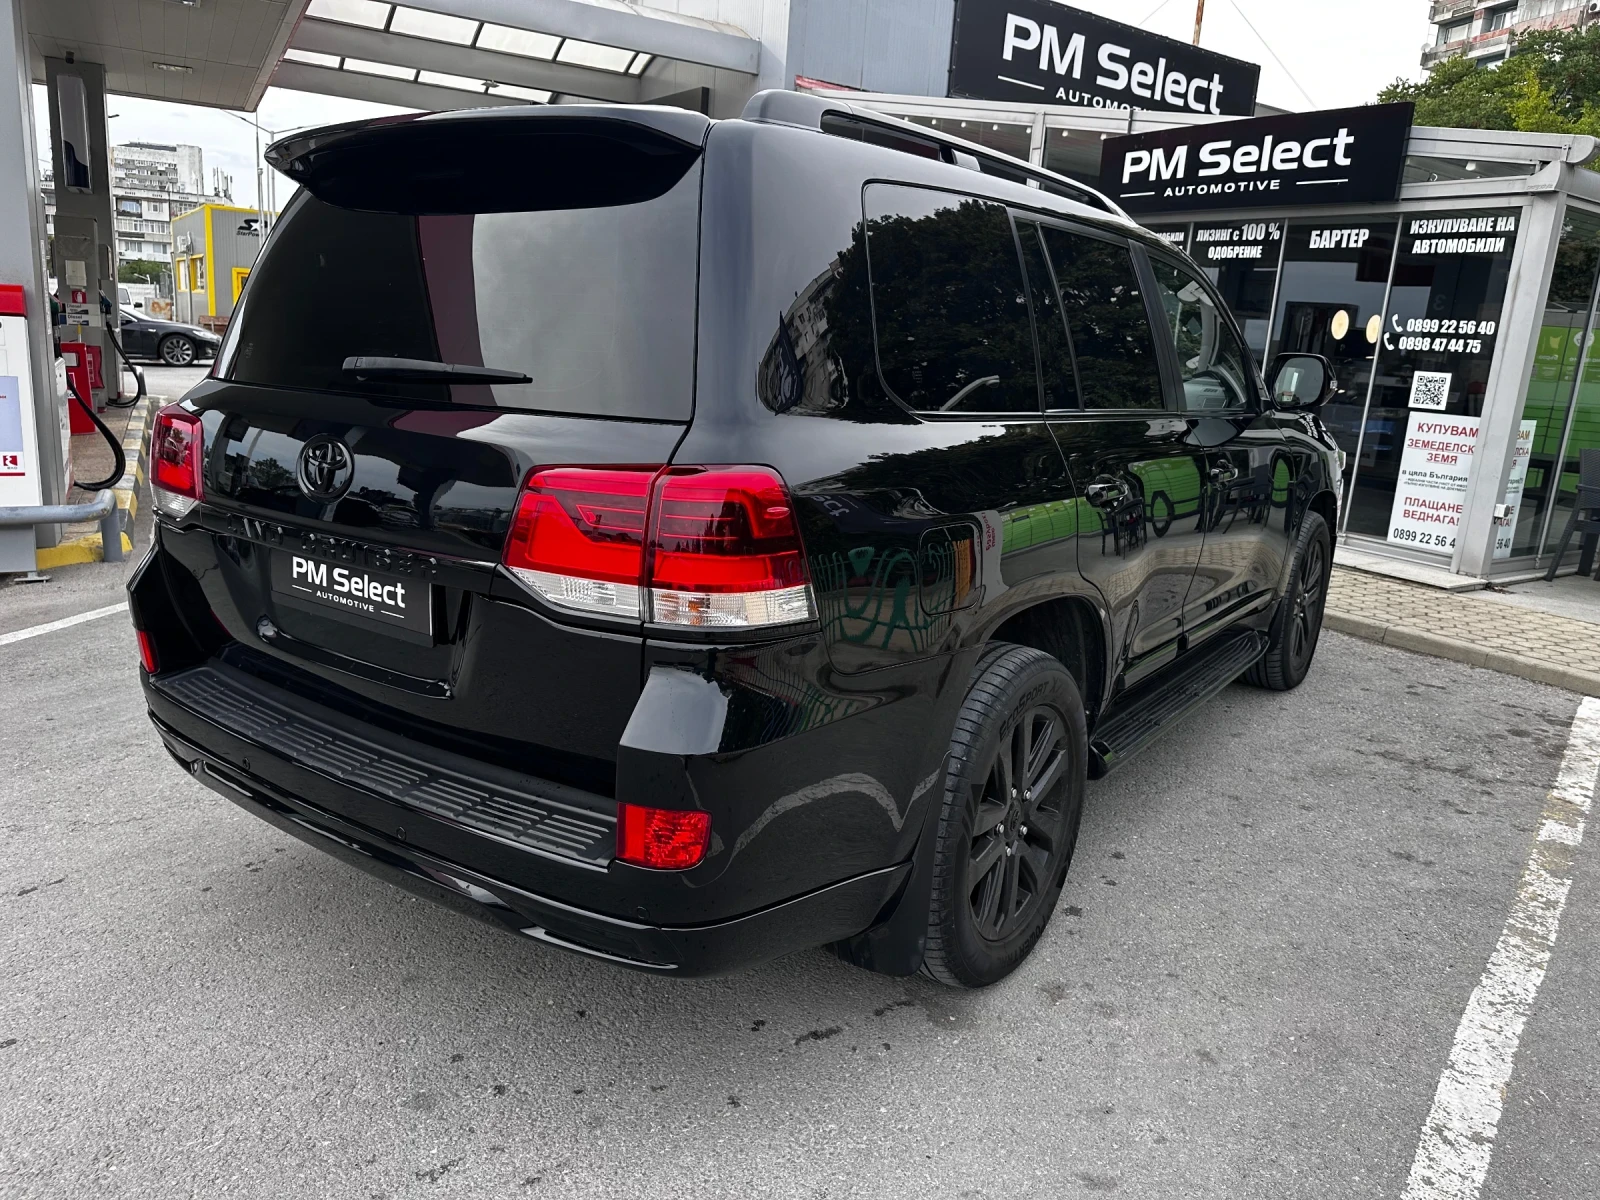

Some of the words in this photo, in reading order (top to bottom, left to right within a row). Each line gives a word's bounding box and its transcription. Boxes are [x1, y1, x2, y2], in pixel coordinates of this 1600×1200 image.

[1002, 13, 1086, 80] PM
[1096, 43, 1223, 115] Select
[1055, 87, 1152, 112] AUTOMO
[1121, 145, 1188, 184] PM
[1198, 128, 1354, 177] Select
[1163, 179, 1280, 197] AUTOMOTIVE
[1196, 229, 1232, 242] ЛИЗИНГ
[1241, 223, 1266, 241] 100
[1268, 222, 1280, 240] %
[1410, 217, 1494, 234] ИЗКУПУВАНЕ
[1495, 216, 1515, 232] НА
[1309, 228, 1370, 249] БАРТЕР
[1411, 237, 1506, 254] АВТОМОБИЛИ
[1208, 246, 1263, 260] ОДОБРЕНИЕ
[1406, 319, 1439, 333] 0899
[1439, 319, 1457, 333] 22
[1458, 320, 1476, 334] 56
[1477, 321, 1495, 335] 40
[1398, 336, 1431, 351] 0898
[1431, 338, 1447, 352] 47
[1447, 338, 1464, 352] 44
[1465, 339, 1481, 353] 75
[1417, 422, 1479, 438] КУПУВАМ
[1407, 438, 1475, 454] ЗЕМЕДЕЛСК
[1426, 452, 1458, 465] ЗЕМЯ
[1429, 471, 1468, 482] България
[1404, 496, 1464, 514] ПЛАЩАНЕ
[1403, 509, 1460, 527] ВЕДНАГА!
[226, 513, 284, 546] LAND
[301, 532, 438, 580] CRUISER
[1393, 528, 1417, 542] 0899
[1419, 532, 1432, 544] 22
[1434, 535, 1447, 547] 56
[1449, 537, 1456, 548] 4
[292, 556, 327, 587] PM
[333, 567, 405, 608] Select
[316, 590, 375, 612] AUTOMOTIVE
